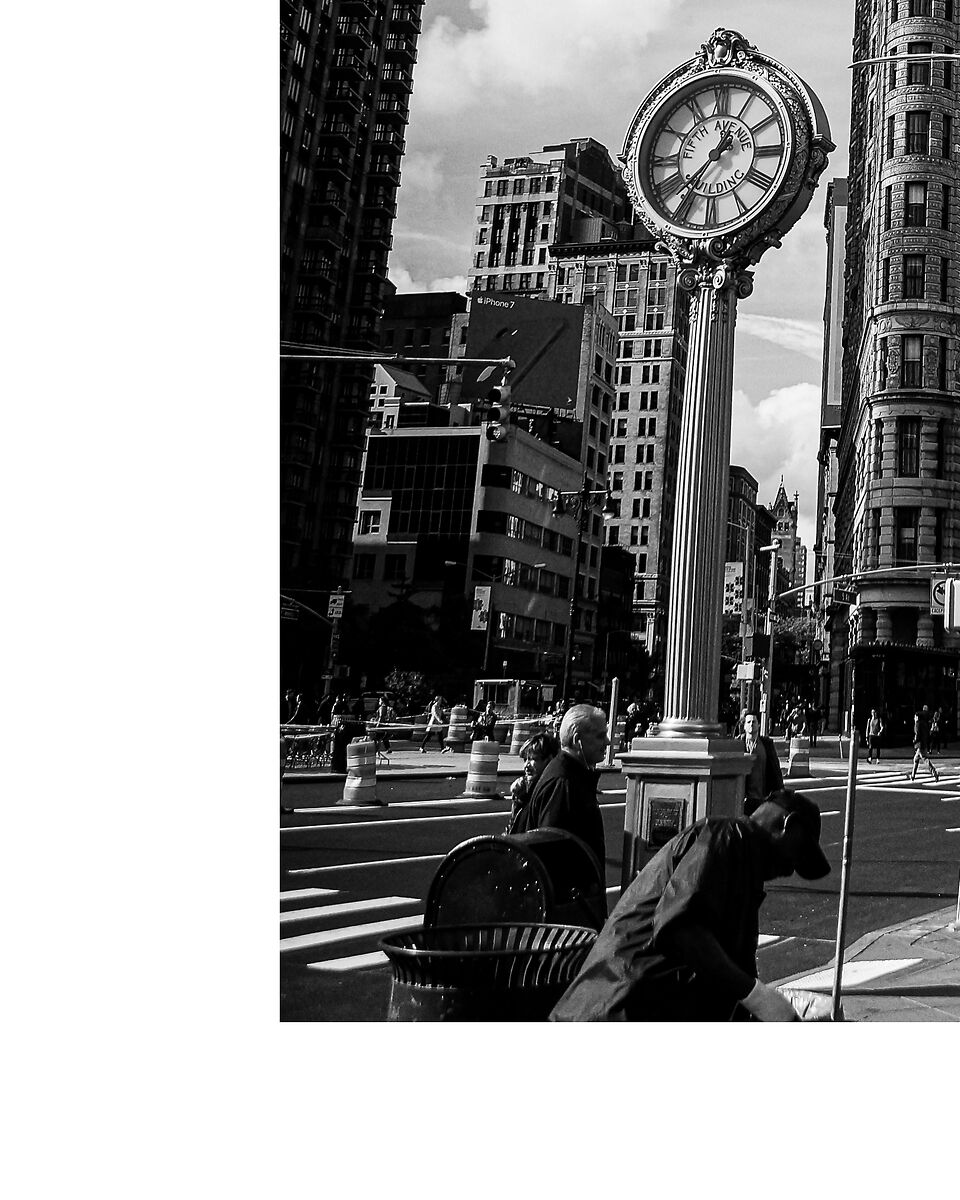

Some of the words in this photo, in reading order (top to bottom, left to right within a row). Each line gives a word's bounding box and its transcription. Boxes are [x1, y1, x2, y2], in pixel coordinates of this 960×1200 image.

[683, 125, 709, 159] FIFTH
[714, 120, 752, 152] AVENUE
[692, 168, 745, 194] UILDING
[483, 297, 509, 309] iPhone
[509, 300, 516, 309] 7
